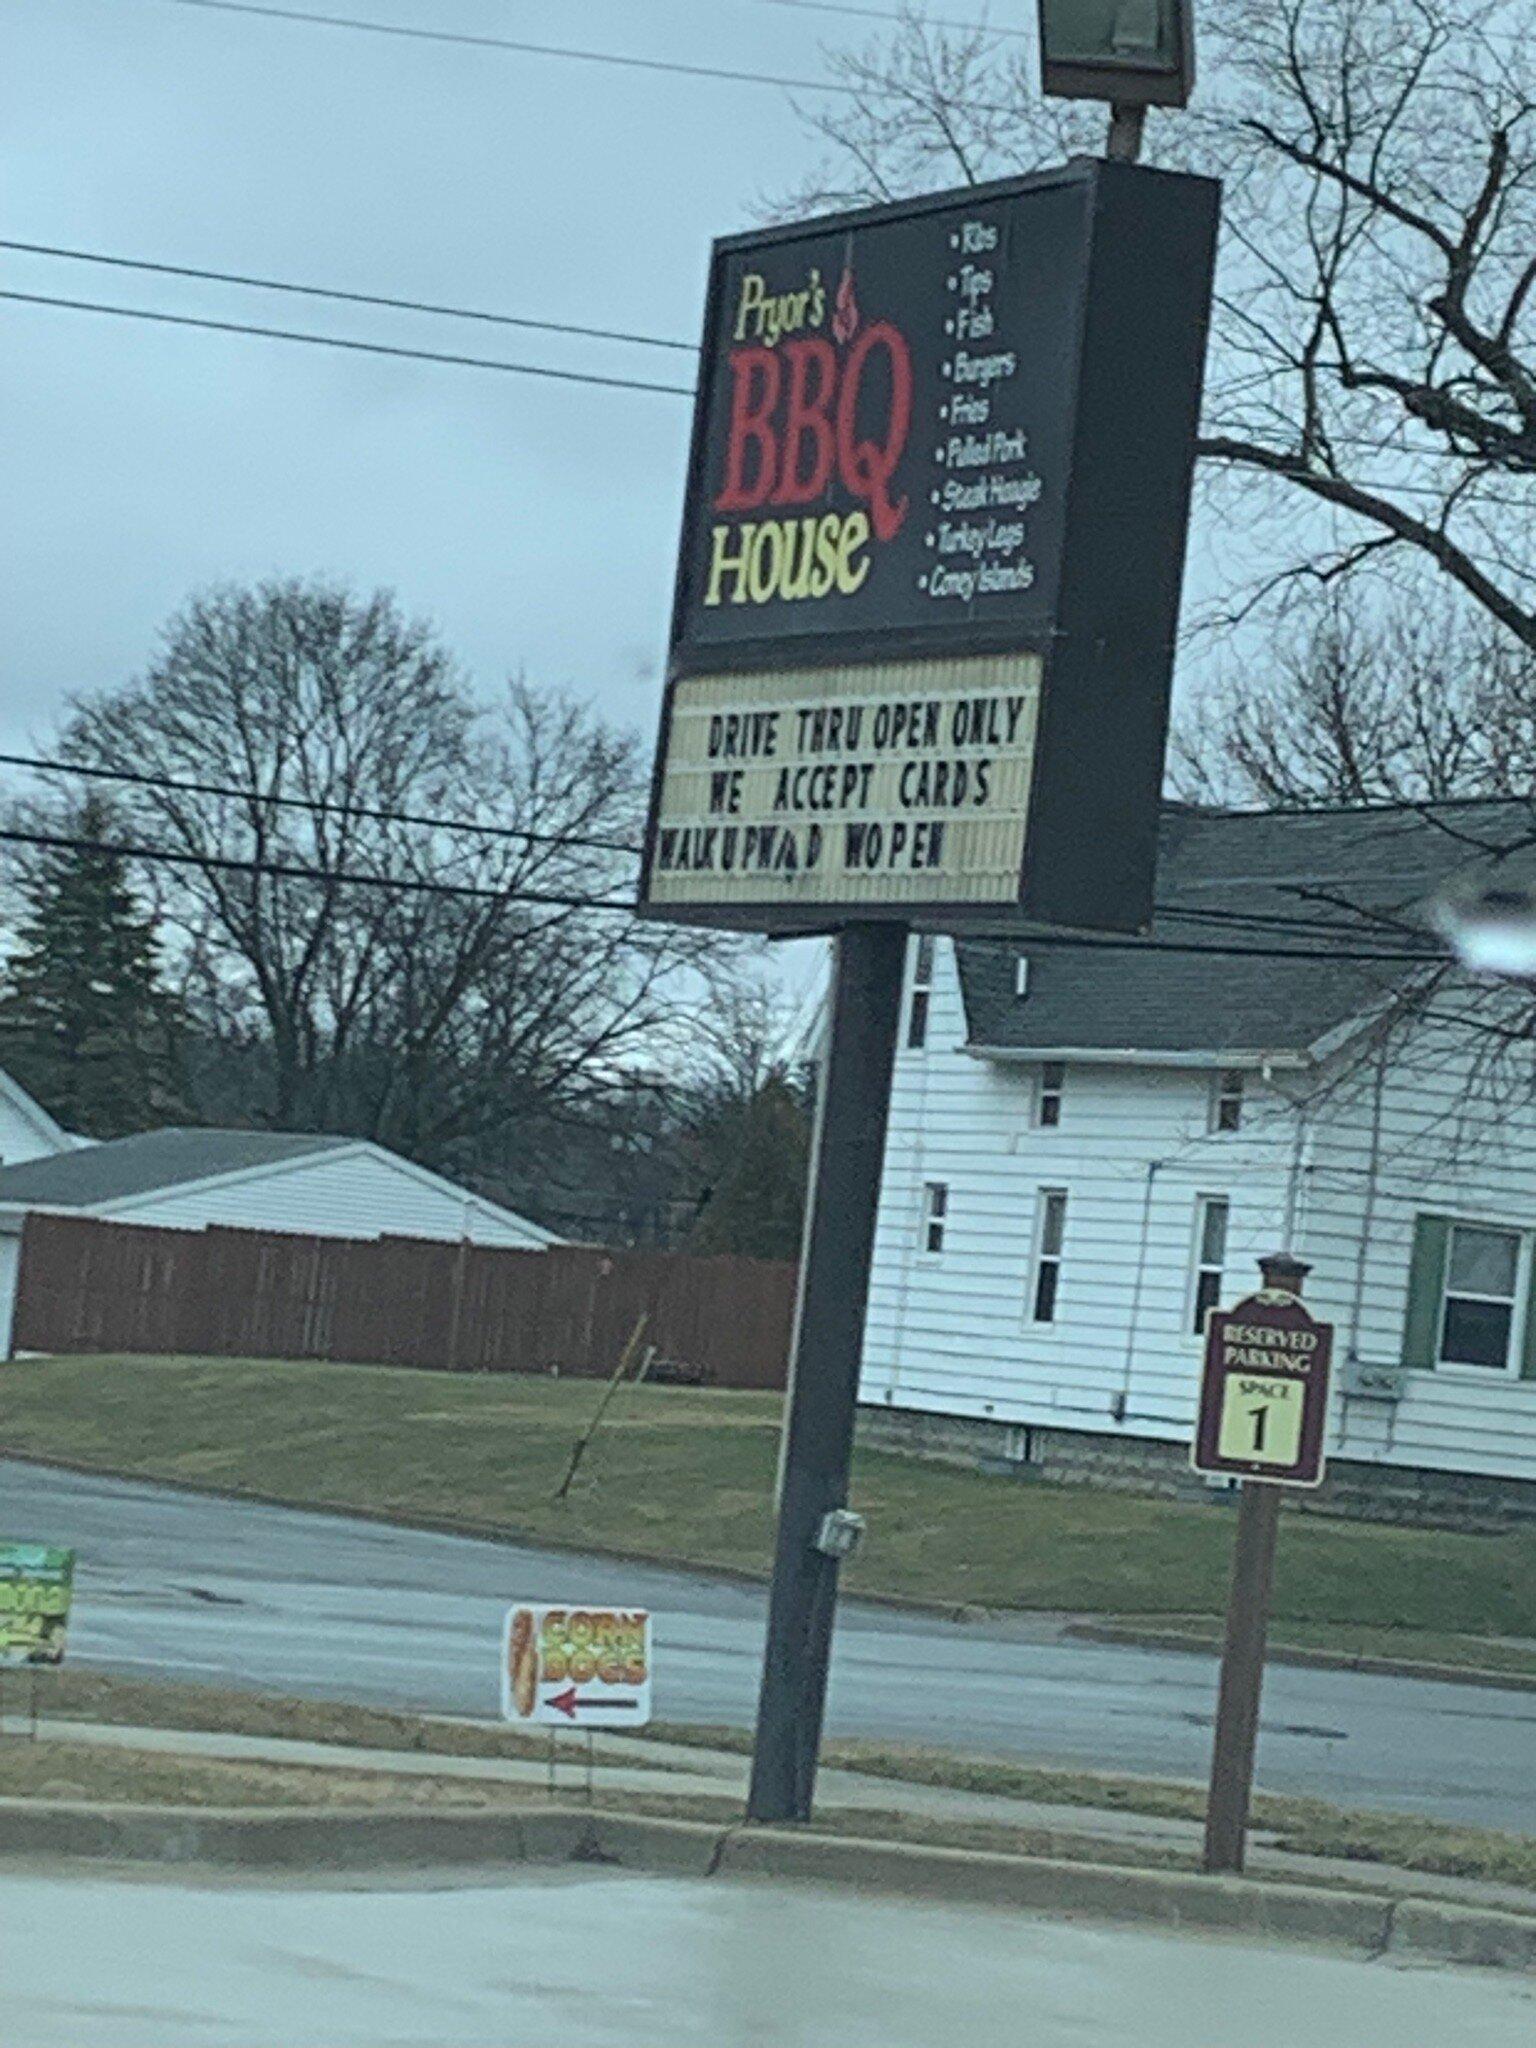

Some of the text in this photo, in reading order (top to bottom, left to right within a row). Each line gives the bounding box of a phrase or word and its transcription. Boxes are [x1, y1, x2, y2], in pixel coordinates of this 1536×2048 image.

[715, 321, 916, 541] BBQ
[707, 697, 1026, 758] DRIVE THRU OPEN ONLY
[709, 758, 993, 814] WE ACCEPT CARDS
[1223, 1325, 1318, 1350] RESERVED
[1224, 1347, 1311, 1371] PARKING
[1238, 1380, 1291, 1400] SPACE
[1248, 1405, 1269, 1451] 1
